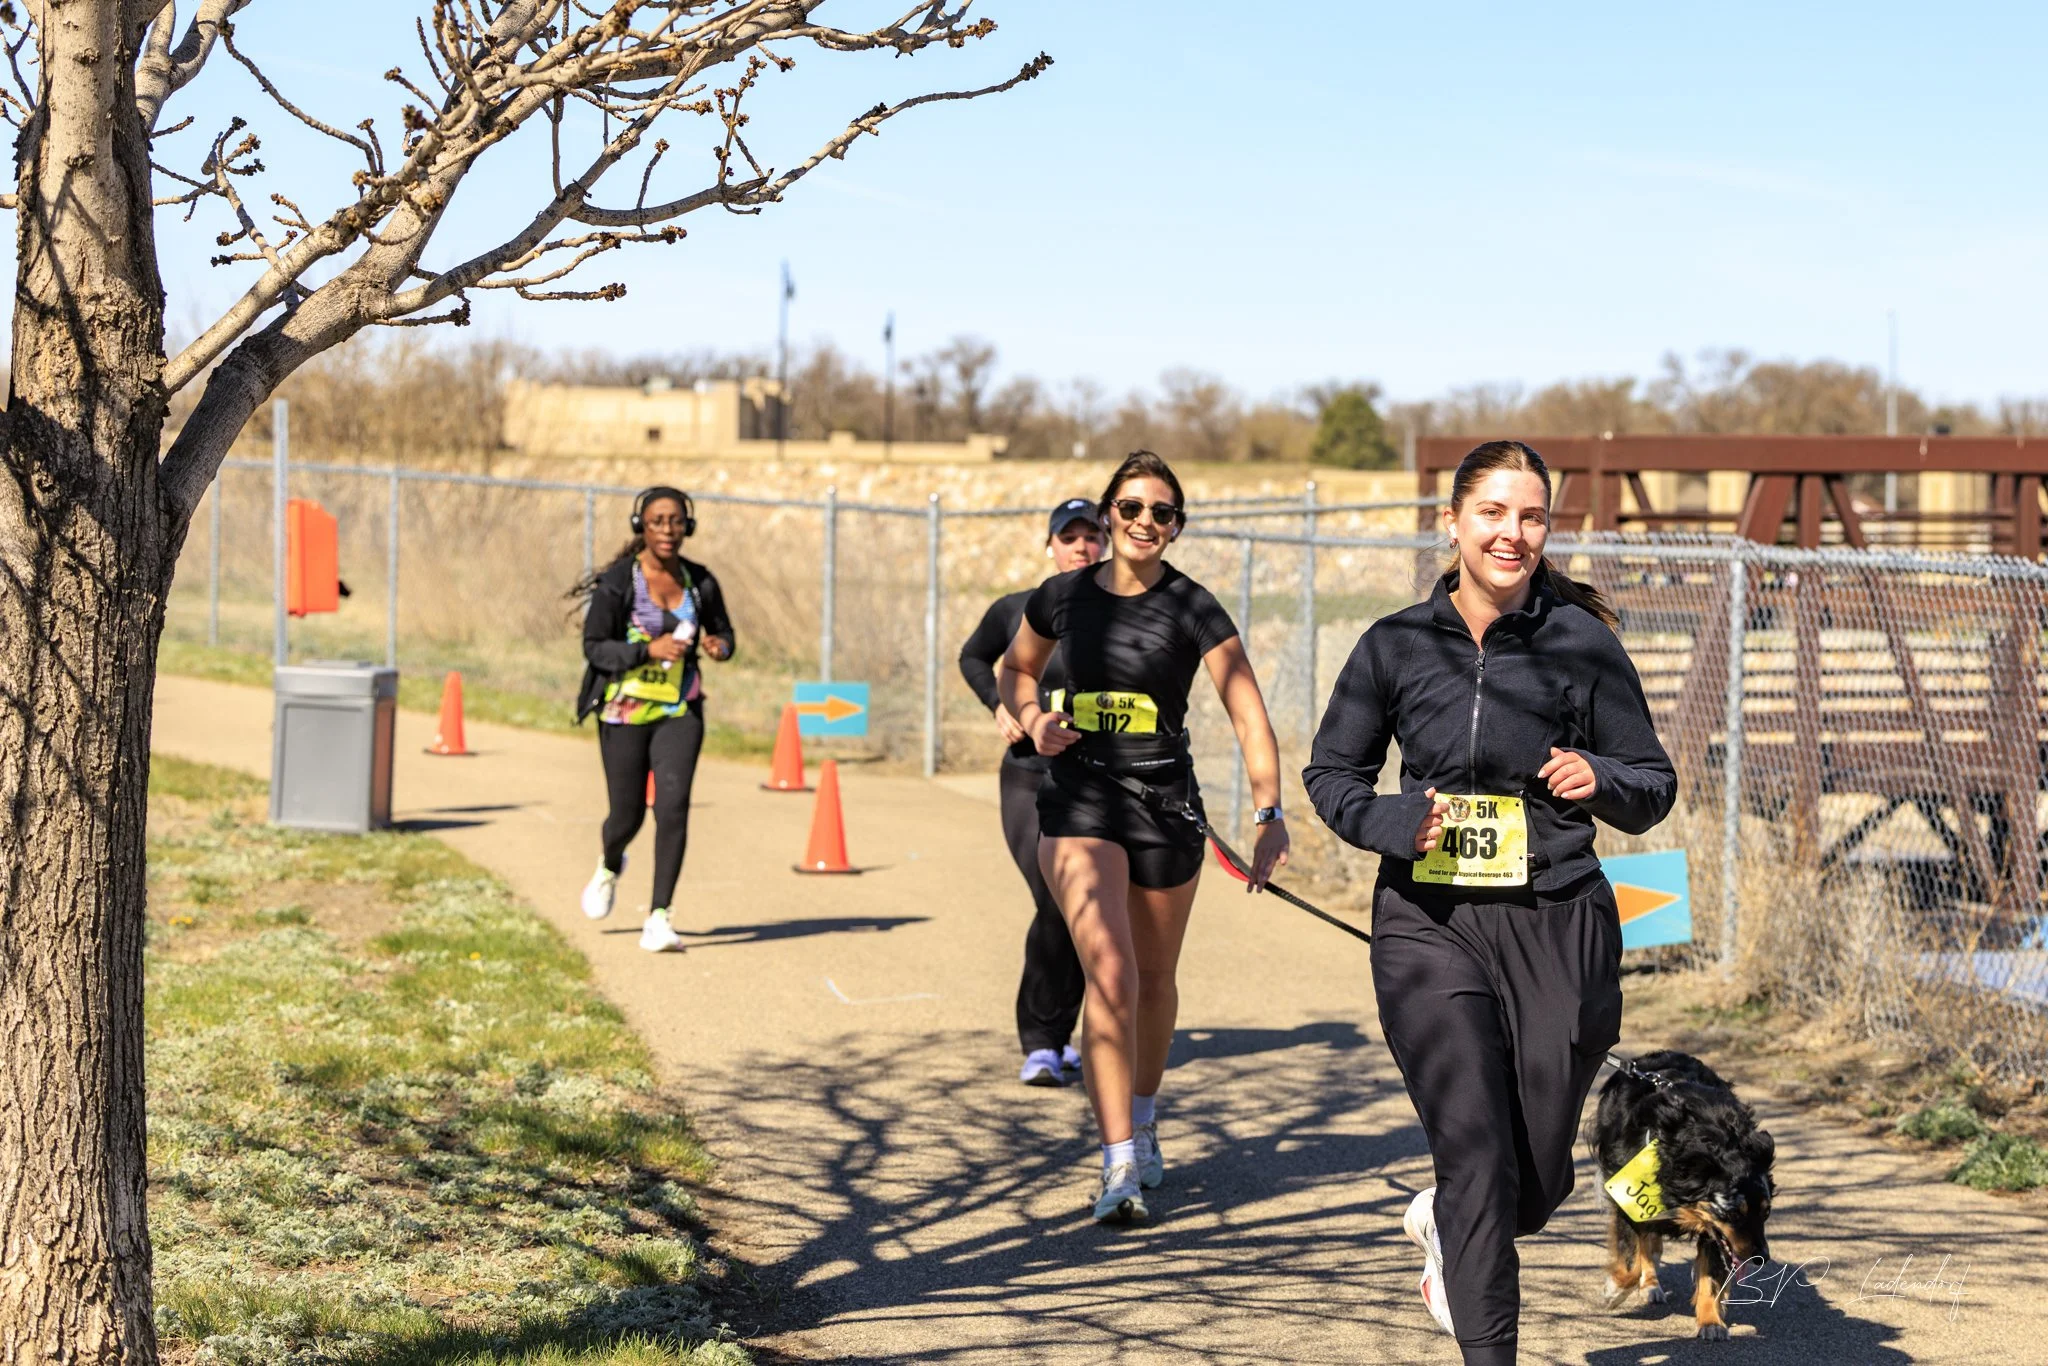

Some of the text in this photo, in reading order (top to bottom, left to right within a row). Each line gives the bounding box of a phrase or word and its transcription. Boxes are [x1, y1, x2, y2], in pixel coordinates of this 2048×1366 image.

[1118, 697, 1136, 709] 5K
[1095, 711, 1131, 733] 102
[1476, 801, 1499, 819] 5K
[1441, 825, 1498, 860] 463
